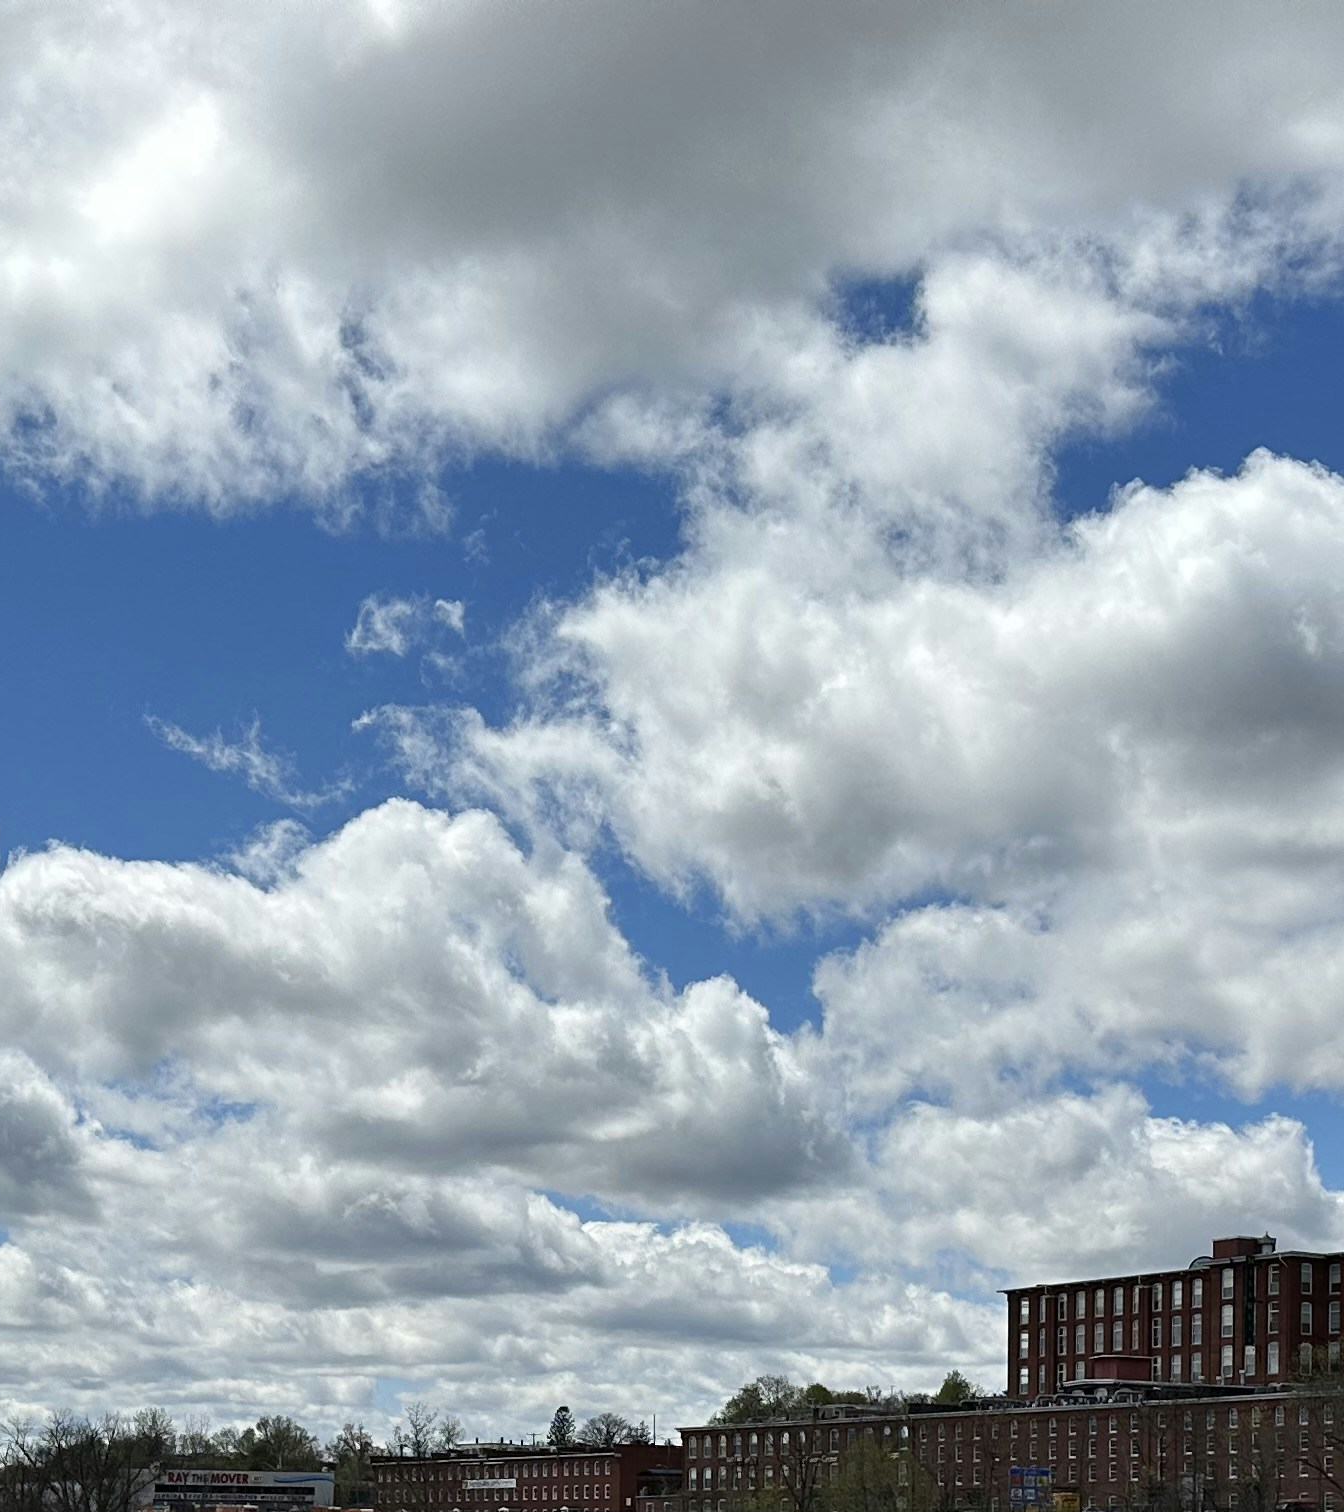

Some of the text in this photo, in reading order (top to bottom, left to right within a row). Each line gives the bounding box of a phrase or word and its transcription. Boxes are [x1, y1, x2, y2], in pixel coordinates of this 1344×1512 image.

[167, 1471, 189, 1483] RAY
[192, 1473, 209, 1483] THE
[210, 1472, 249, 1484] MOVER
